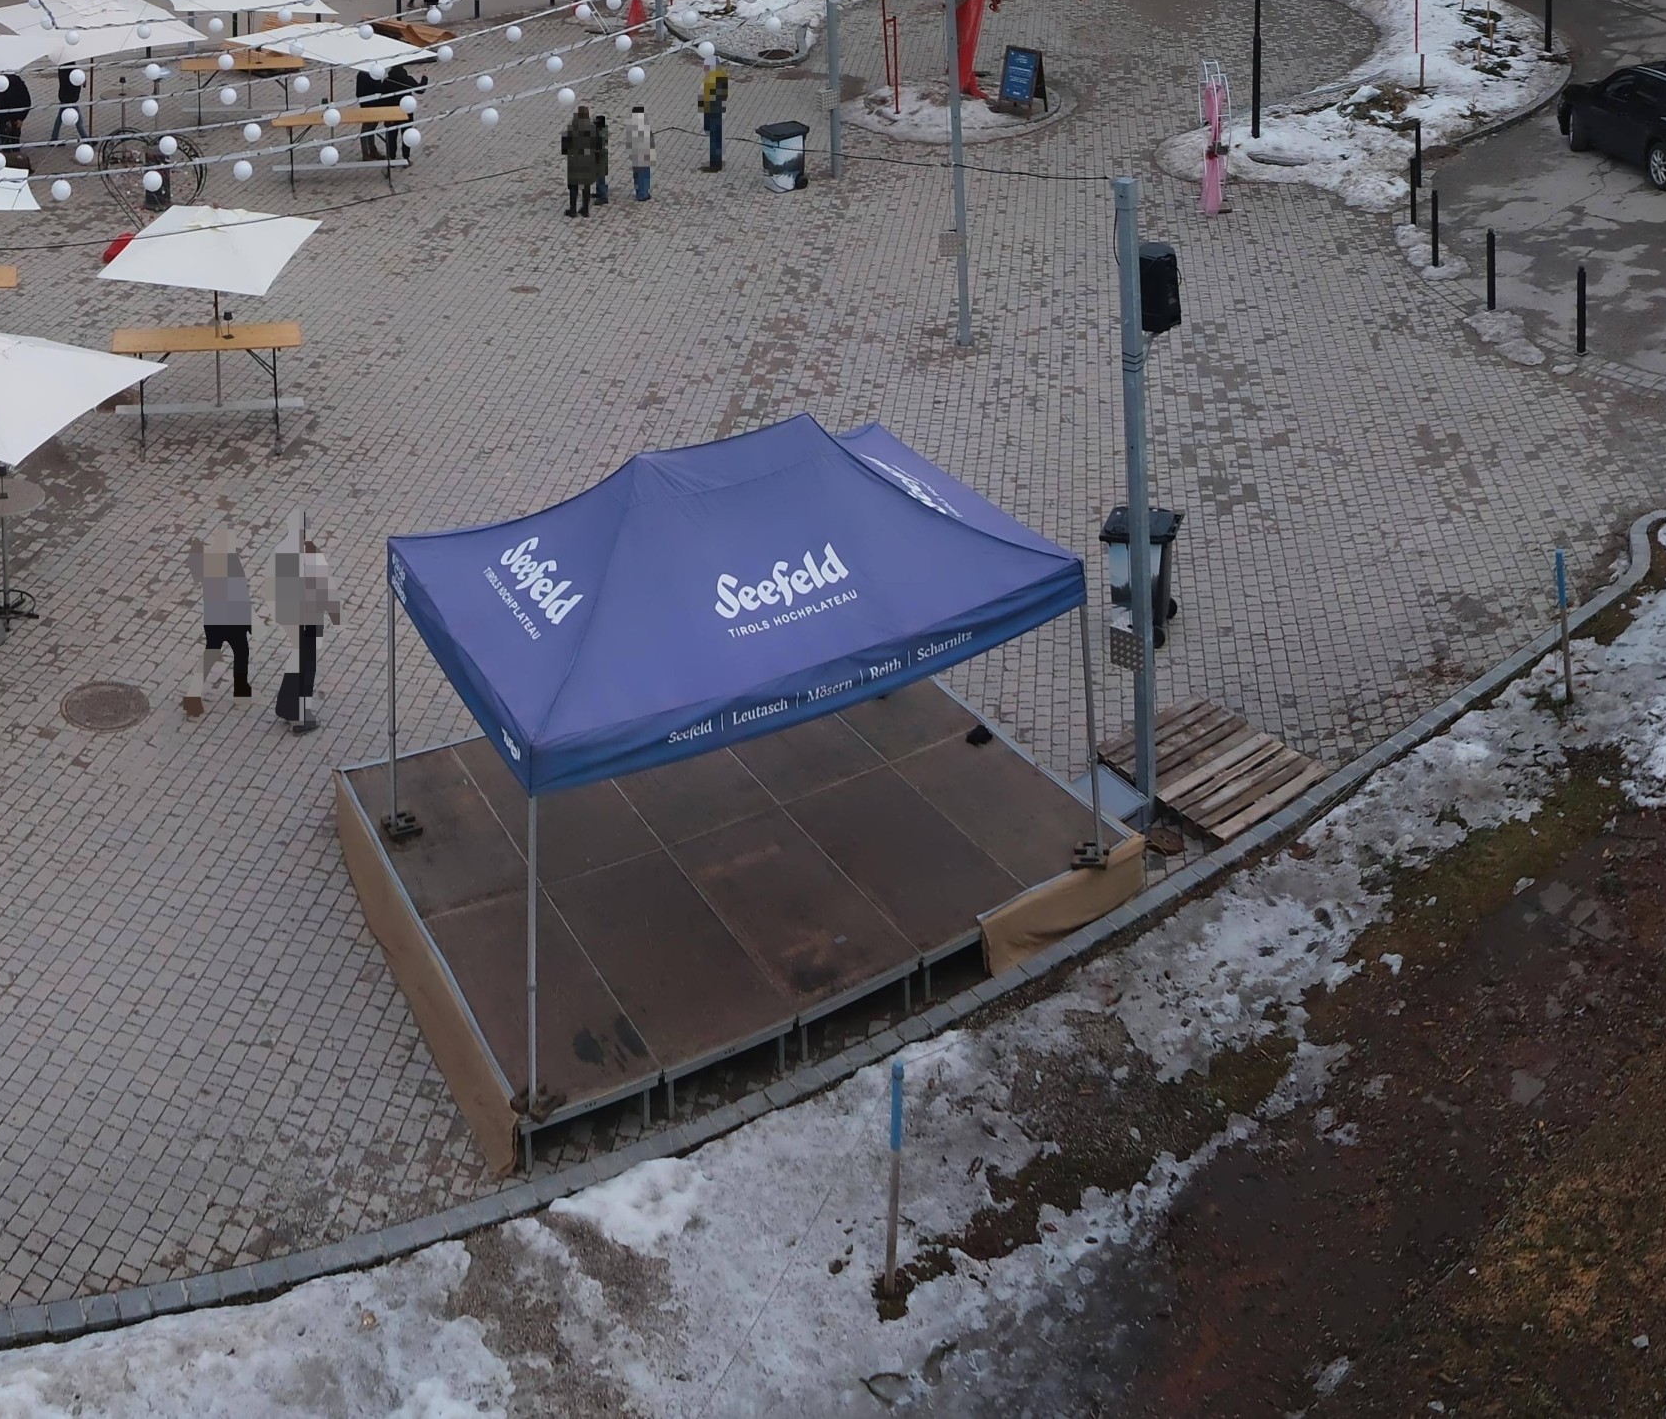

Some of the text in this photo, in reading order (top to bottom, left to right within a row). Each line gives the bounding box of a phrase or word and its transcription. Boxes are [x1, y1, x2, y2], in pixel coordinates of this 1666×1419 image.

[483, 566, 542, 641] TIROLS HOCHPLATEAU
[501, 537, 584, 625] Seefeld
[715, 542, 849, 619] Seefeld
[728, 589, 858, 638] TIROLS HOCHPLATEAU
[668, 631, 973, 744] Seefeld Leutasch Mösern Reith Scharnitz
